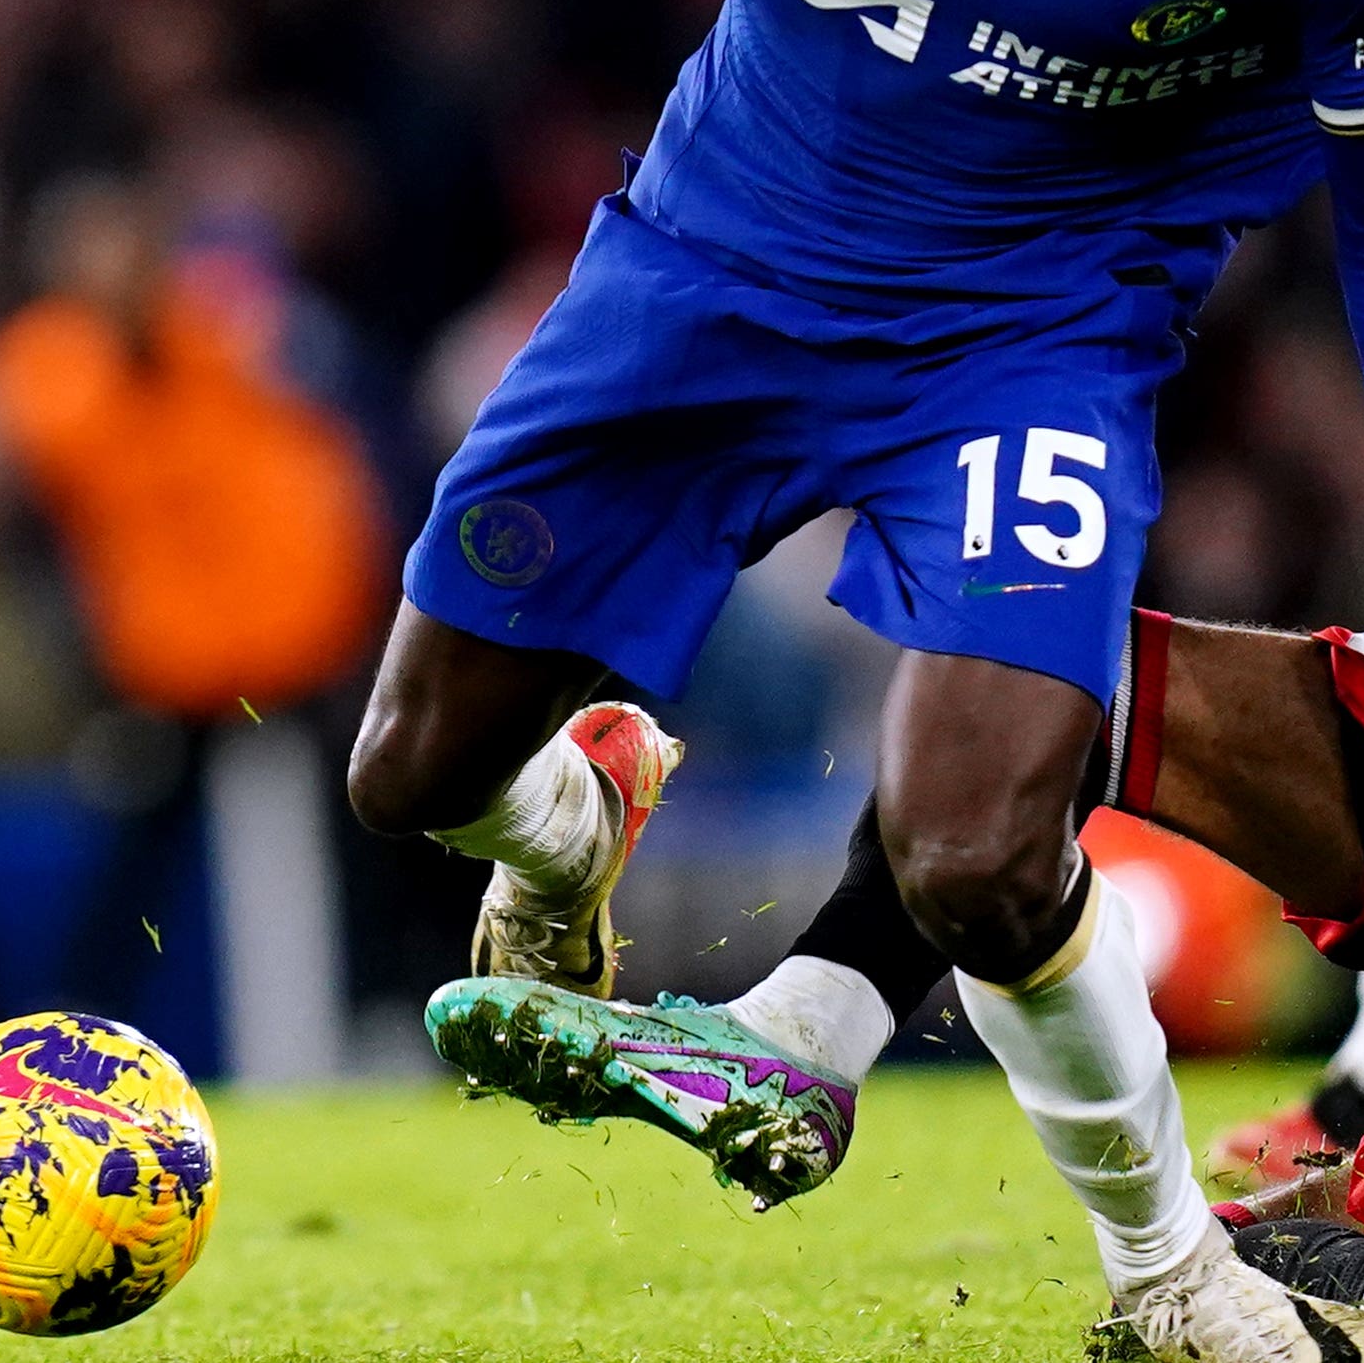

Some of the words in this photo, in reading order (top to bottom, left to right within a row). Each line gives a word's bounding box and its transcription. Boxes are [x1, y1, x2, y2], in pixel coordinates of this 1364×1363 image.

[968, 20, 1265, 84] INFINITE
[948, 61, 1265, 108] ATHLETE
[957, 427, 1107, 569] 15
